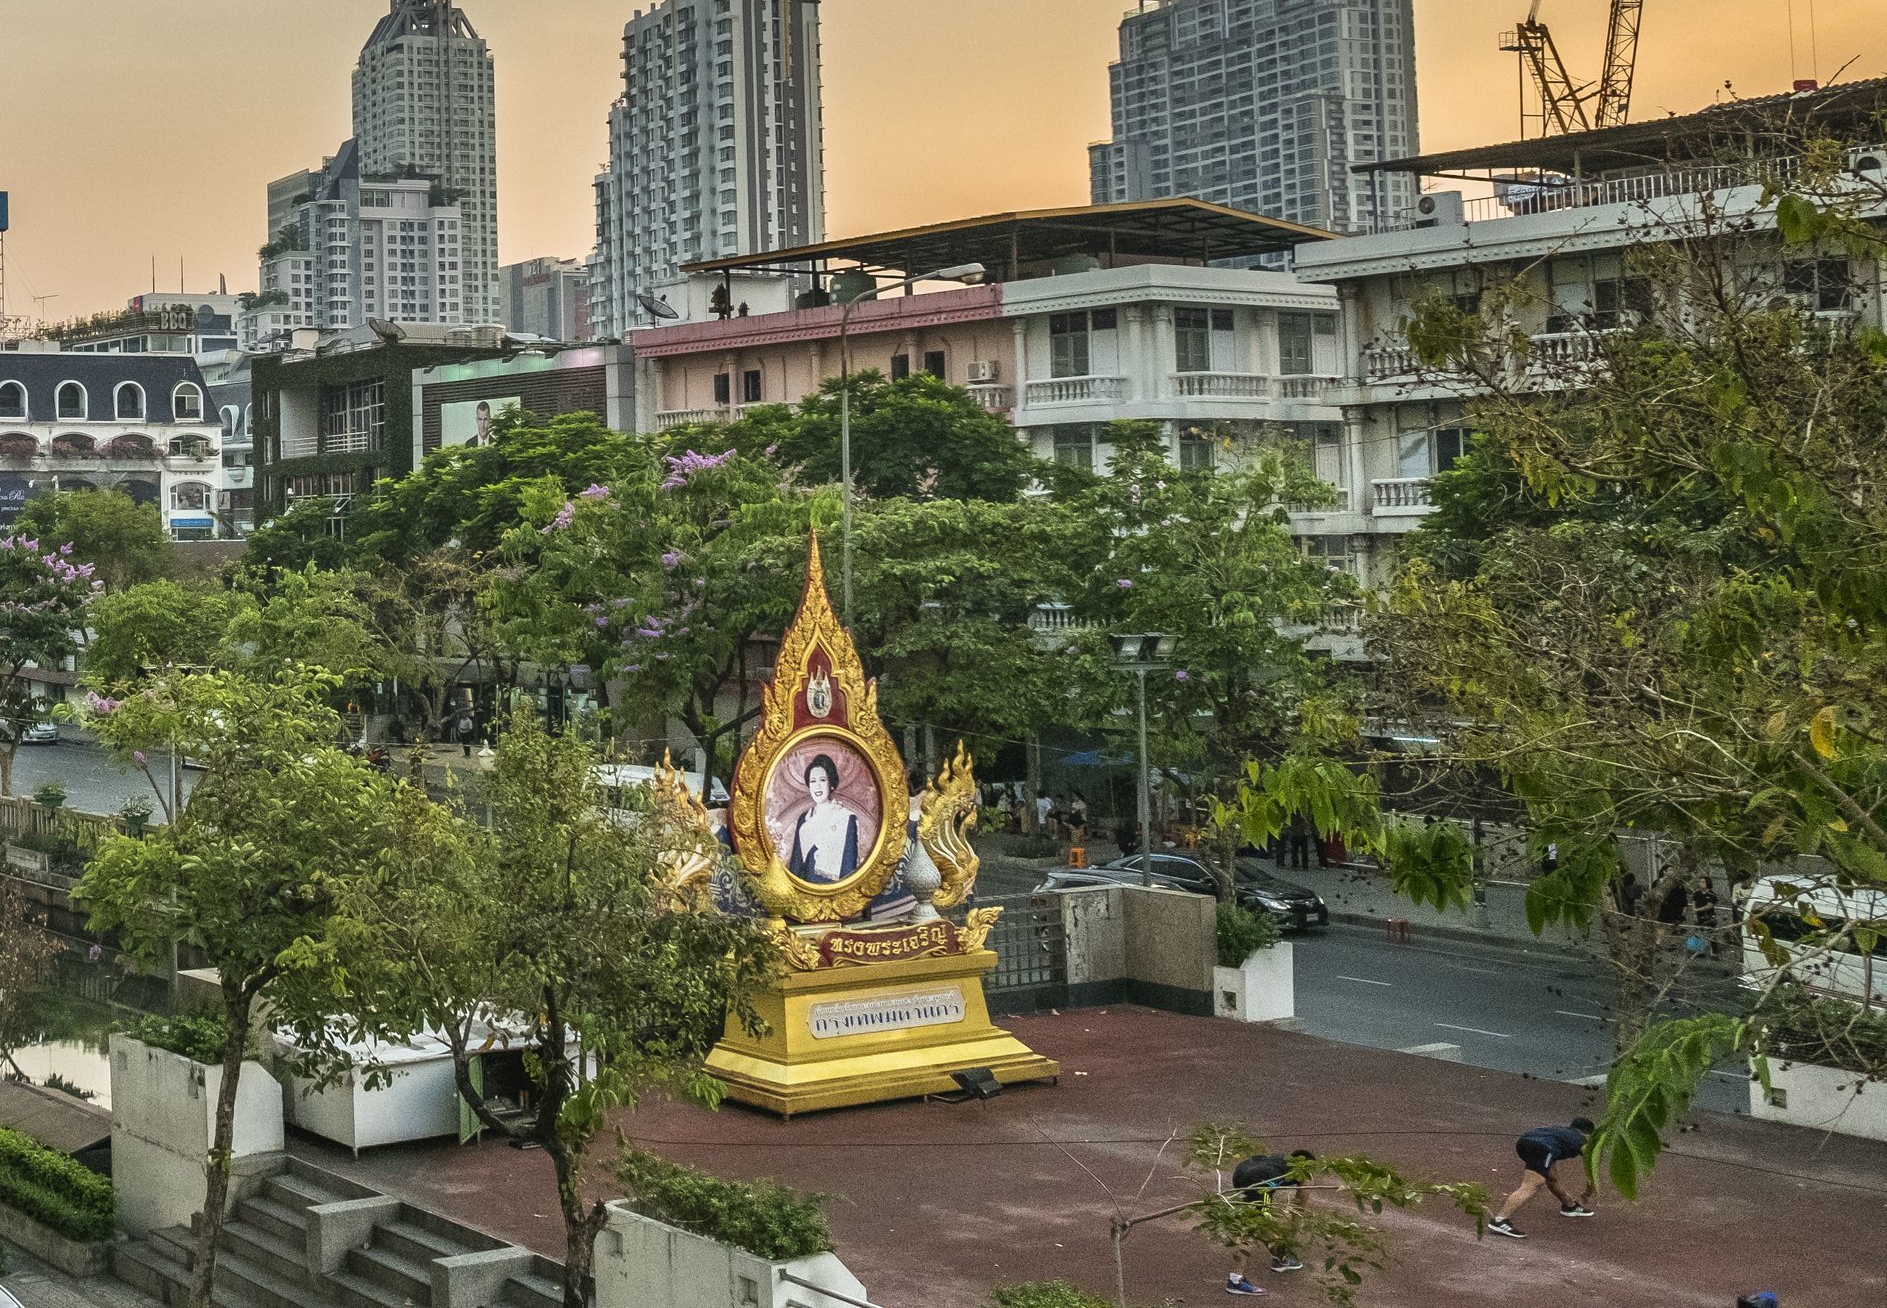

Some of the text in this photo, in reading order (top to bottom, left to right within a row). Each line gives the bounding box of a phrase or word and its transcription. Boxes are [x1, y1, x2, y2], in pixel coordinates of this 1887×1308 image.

[160, 312, 187, 330] BBQ
[830, 924, 949, 956] ทรงพระเจริญ
[815, 1003, 960, 1035] กรุงเทพมหานคร
